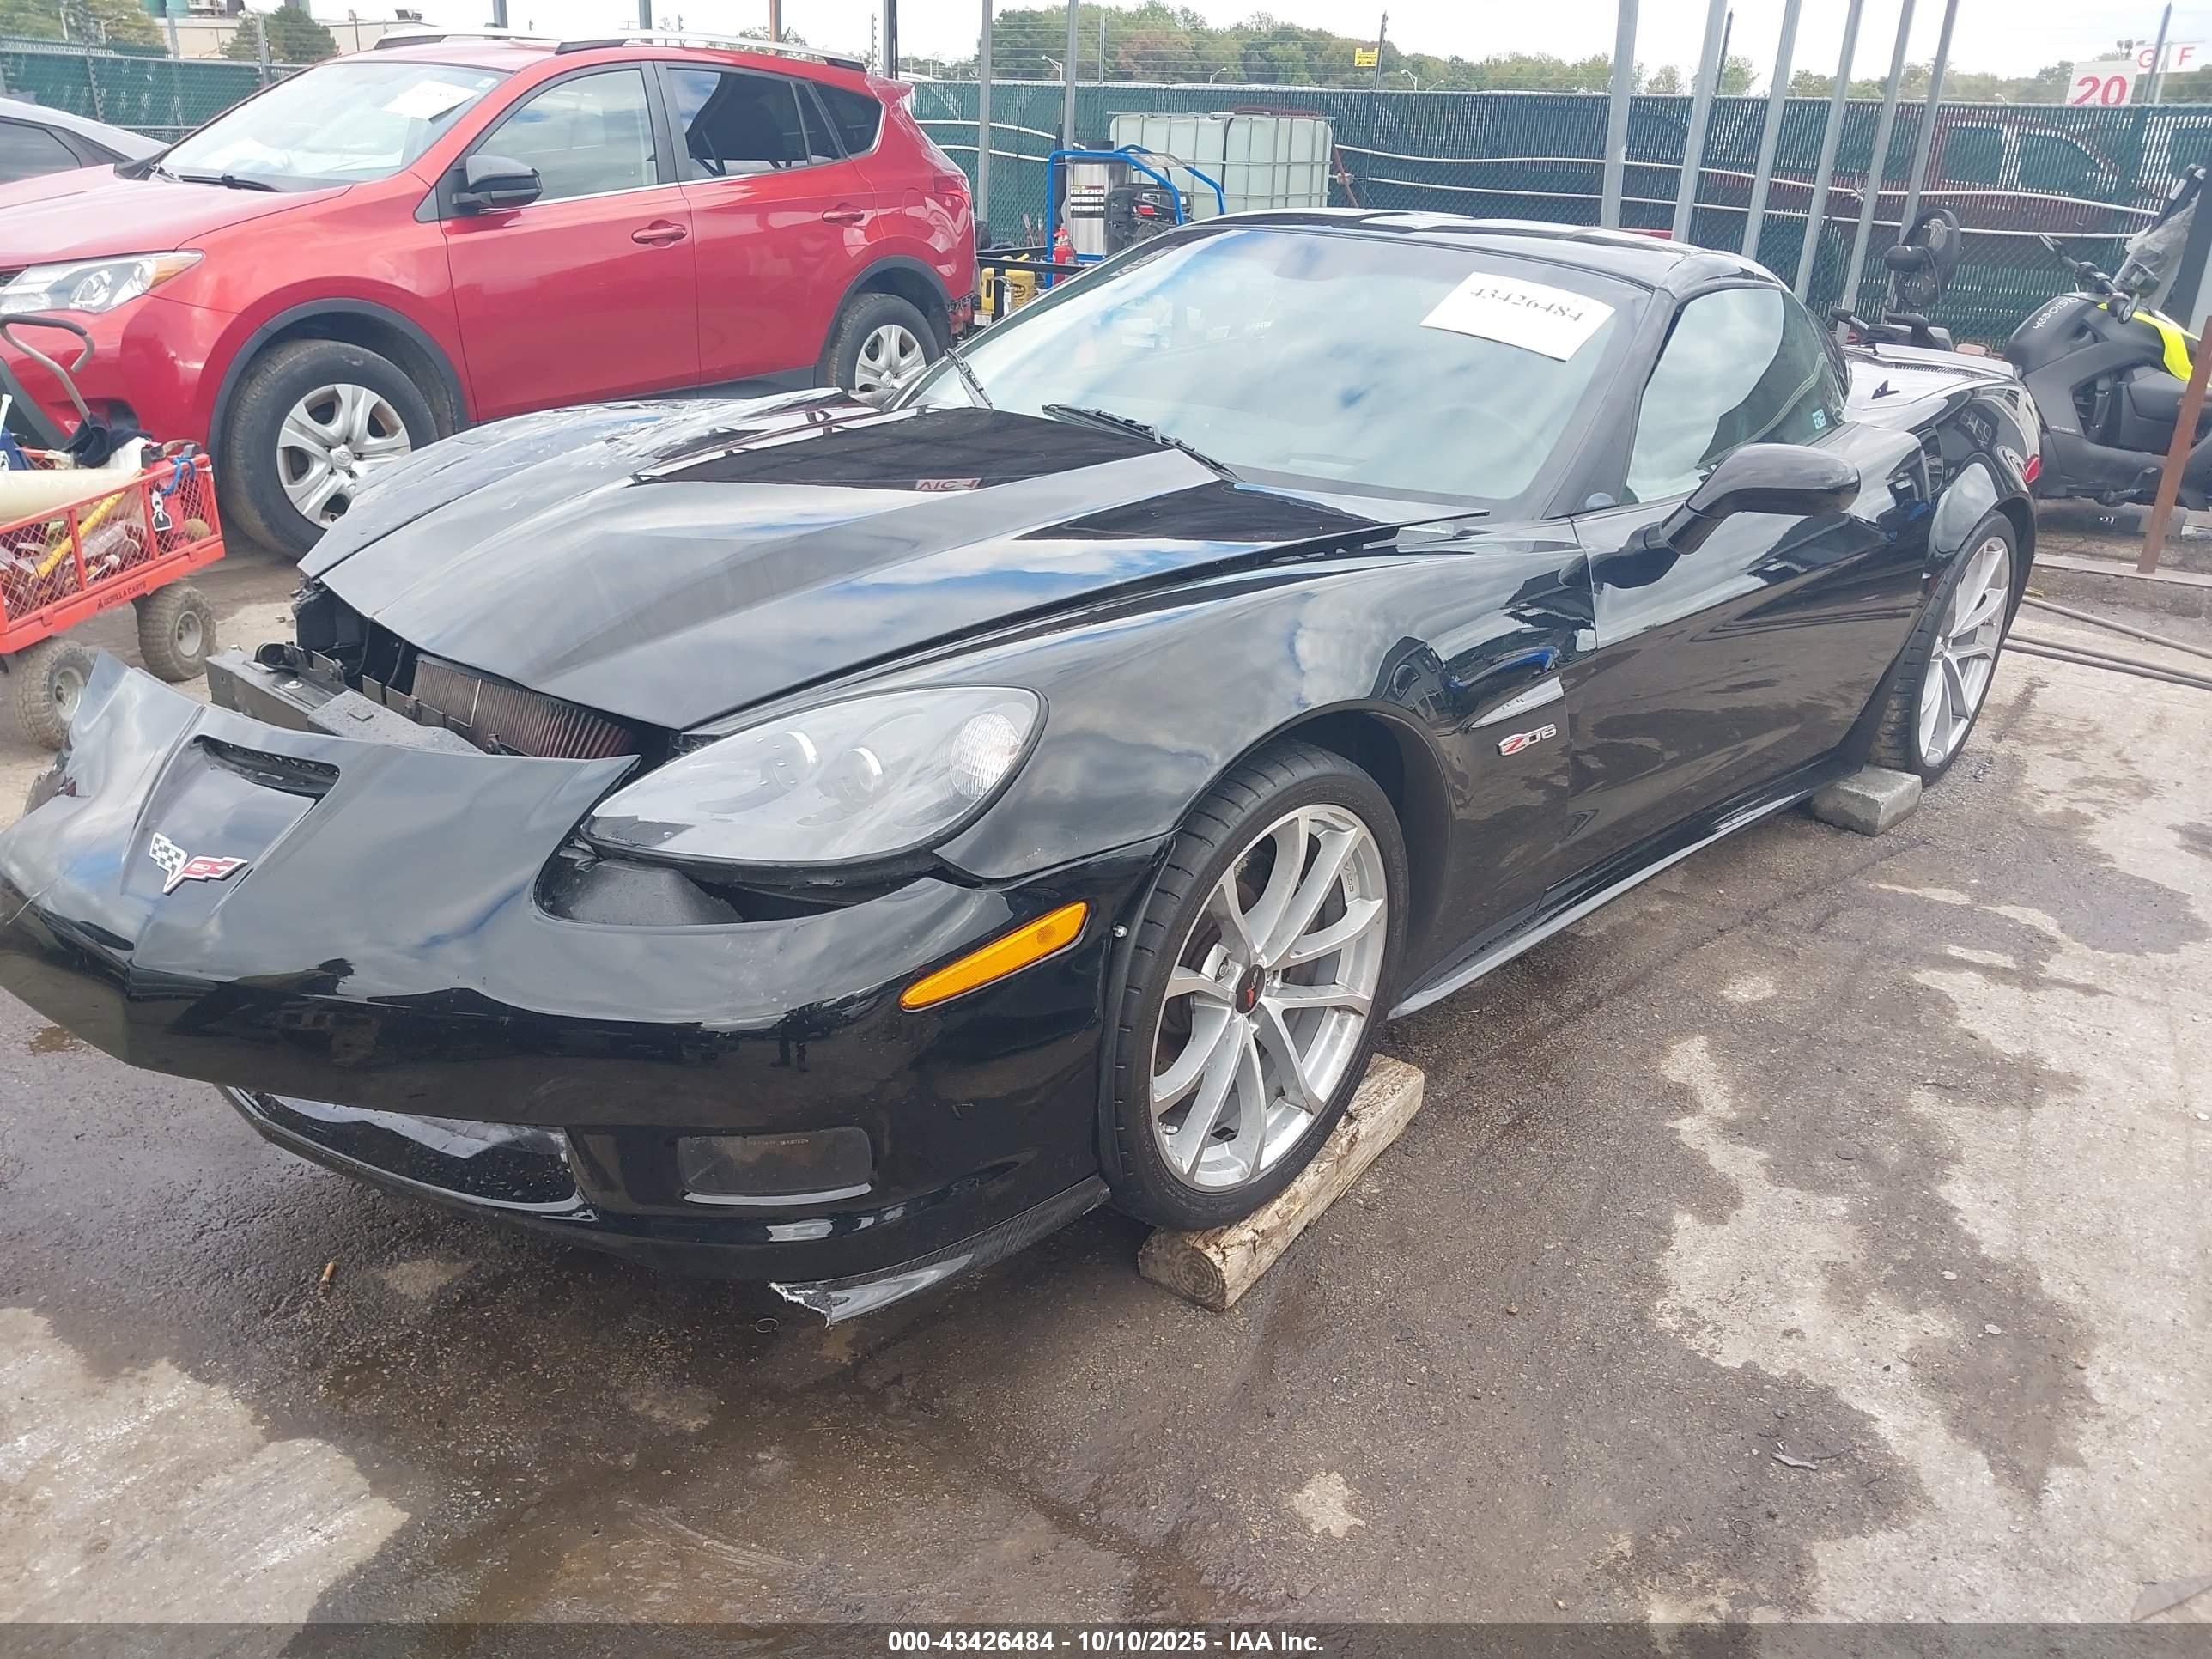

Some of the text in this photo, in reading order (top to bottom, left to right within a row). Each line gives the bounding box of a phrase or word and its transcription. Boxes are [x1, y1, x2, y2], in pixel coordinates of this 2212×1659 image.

[2178, 46, 2196, 67] F
[2073, 75, 2128, 106] 20
[1470, 288, 1583, 322] 43426484
[1499, 724, 1557, 756] Z06
